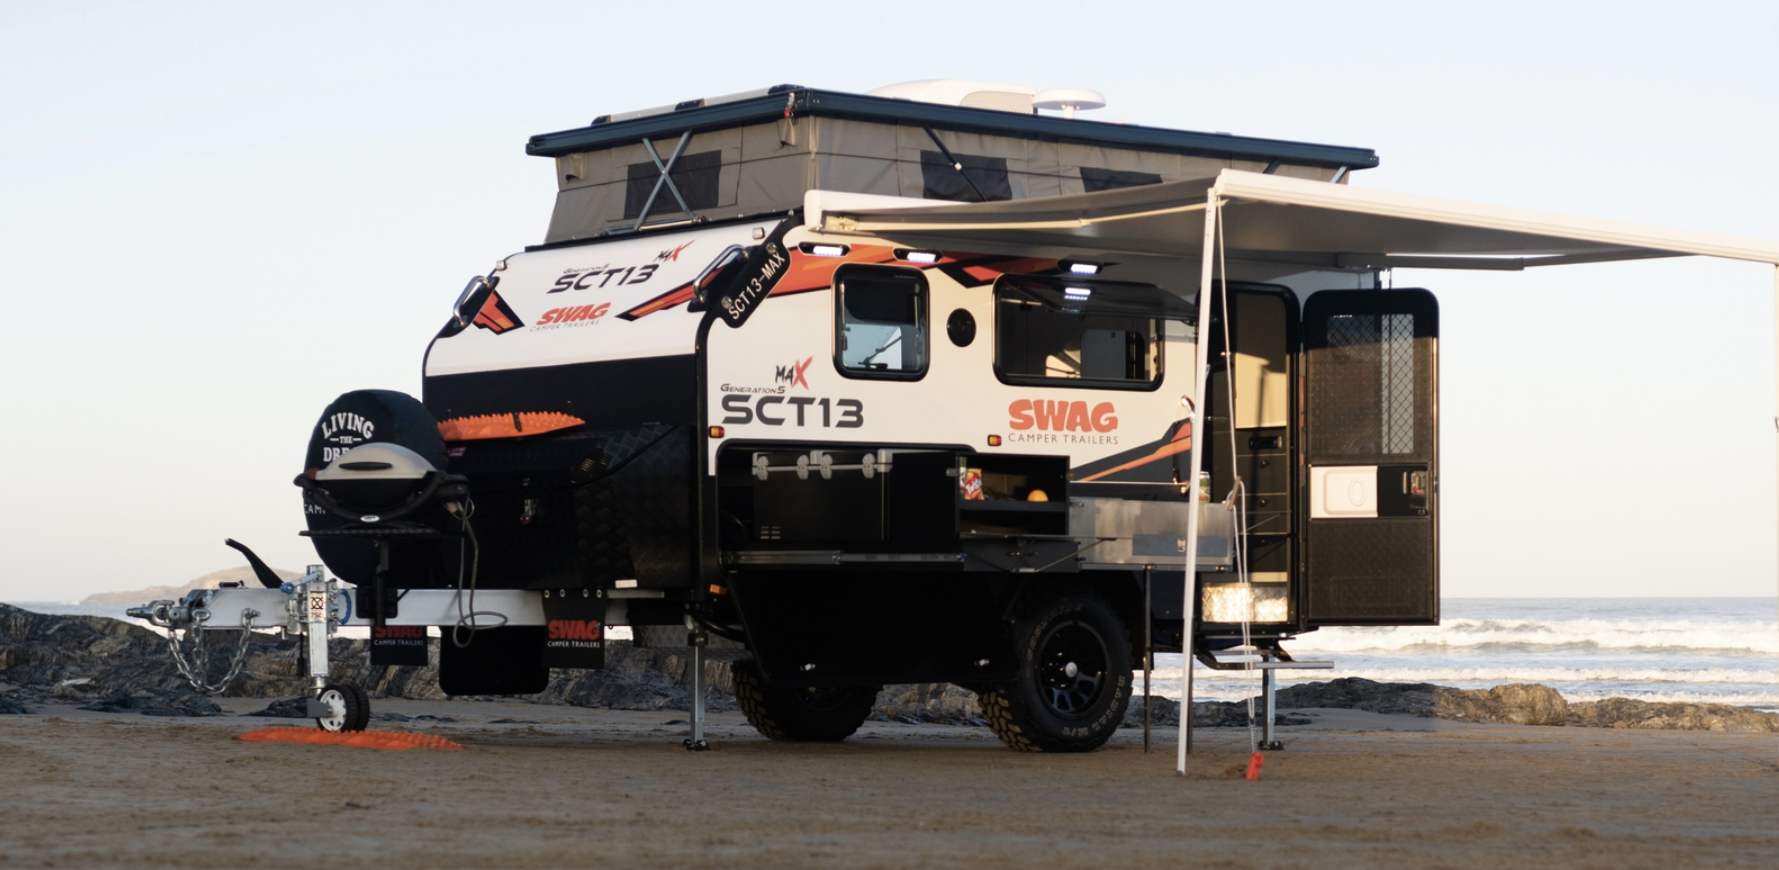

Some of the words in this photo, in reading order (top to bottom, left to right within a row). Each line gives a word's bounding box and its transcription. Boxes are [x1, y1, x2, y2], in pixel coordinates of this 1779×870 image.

[653, 239, 696, 263] MAX
[546, 264, 660, 294] SCT13
[729, 251, 786, 320] SCT13-MAX
[530, 323, 560, 332] CAMPER
[563, 319, 600, 329] TRAILERS
[536, 302, 611, 325] SWAG
[775, 356, 813, 390] MAX
[721, 394, 864, 429] SCT13
[1008, 399, 1118, 433] SWAG
[321, 412, 375, 439] LIVING
[339, 435, 353, 444] THE
[1008, 433, 1058, 443] CAMPER
[1063, 434, 1119, 445] TRAILERS
[374, 626, 423, 639] SWAG
[548, 619, 600, 640] SWAG
